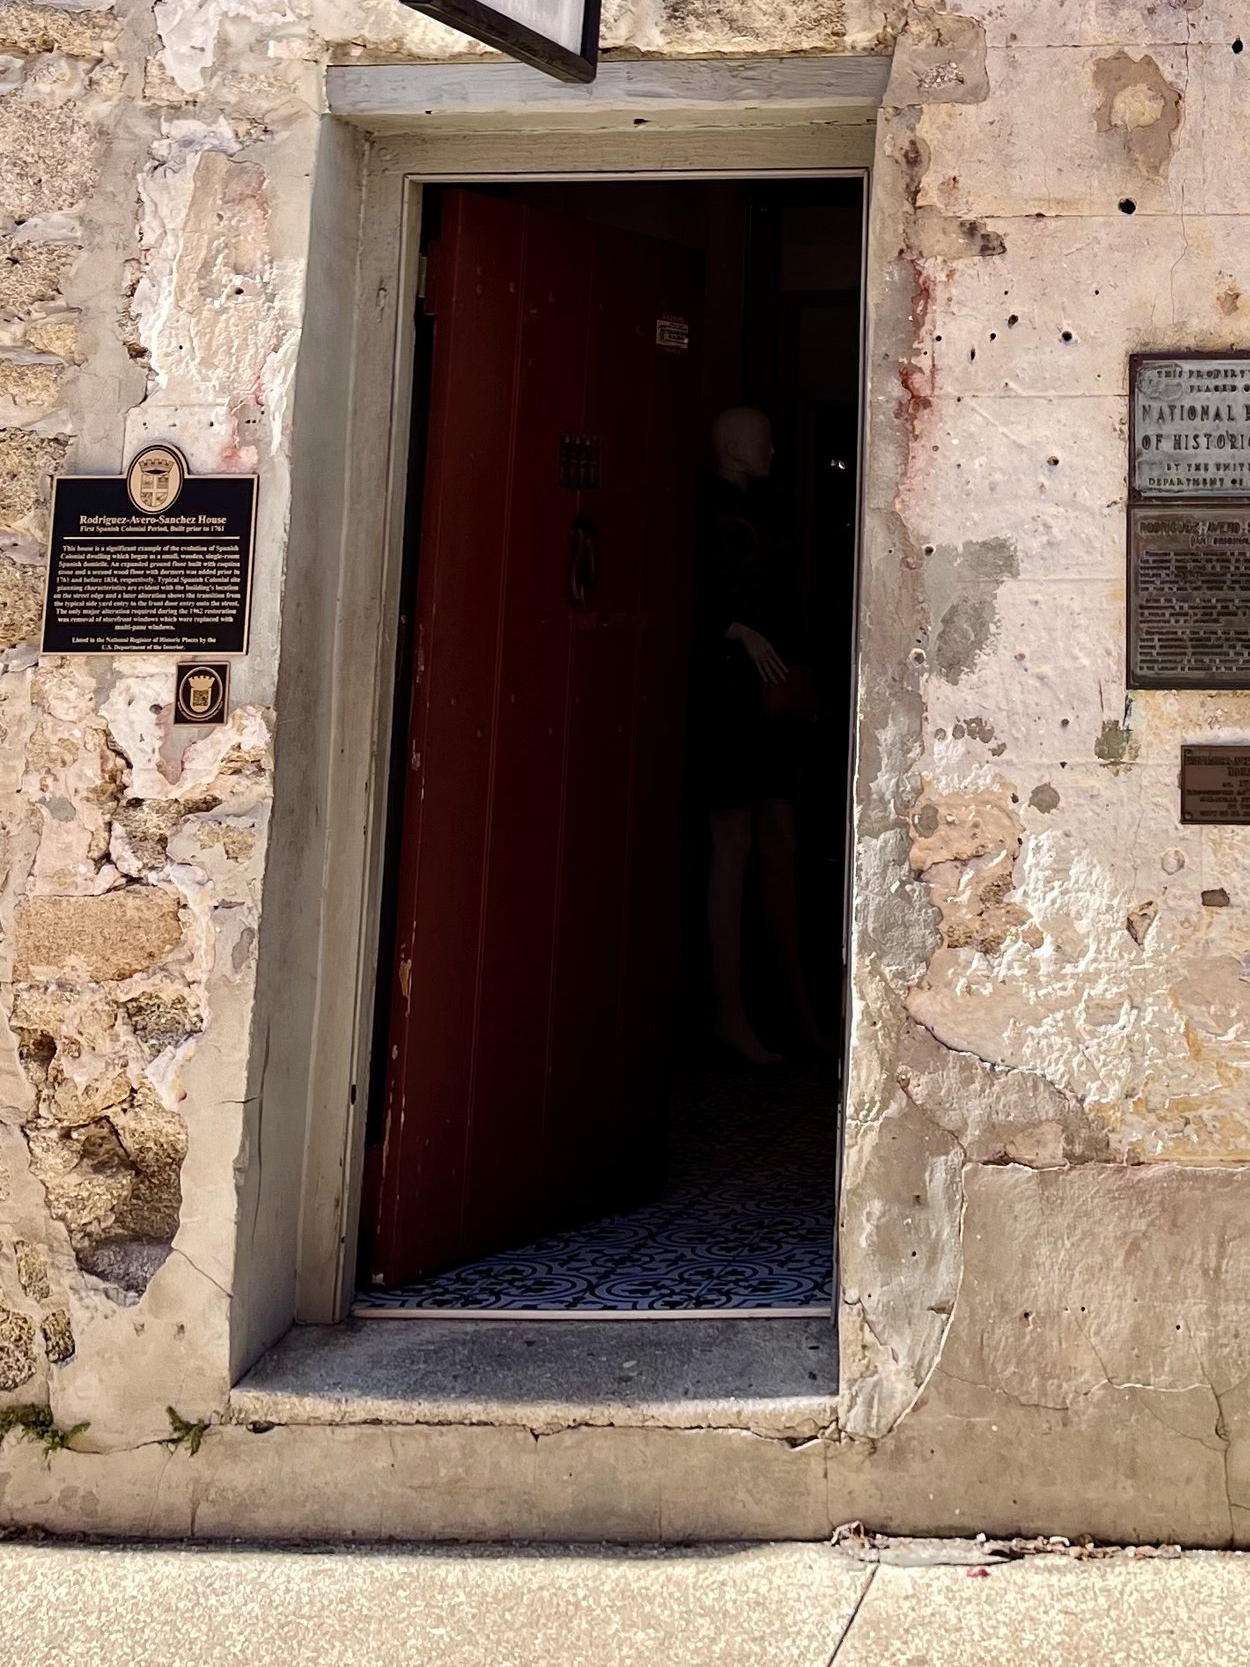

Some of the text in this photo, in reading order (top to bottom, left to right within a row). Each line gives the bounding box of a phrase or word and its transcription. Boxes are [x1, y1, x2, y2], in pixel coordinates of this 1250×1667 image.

[1157, 369, 1182, 379] THIS
[1189, 384, 1237, 393] PLACED
[1141, 404, 1236, 422] NATIONAL
[1141, 433, 1164, 451] OF
[1166, 462, 1181, 472] BY
[1186, 462, 1209, 472] THE
[1148, 477, 1225, 487] DEPARTMENT
[1230, 477, 1244, 486] OF
[80, 515, 227, 526] Rodriguez-Avero-Sanchez House
